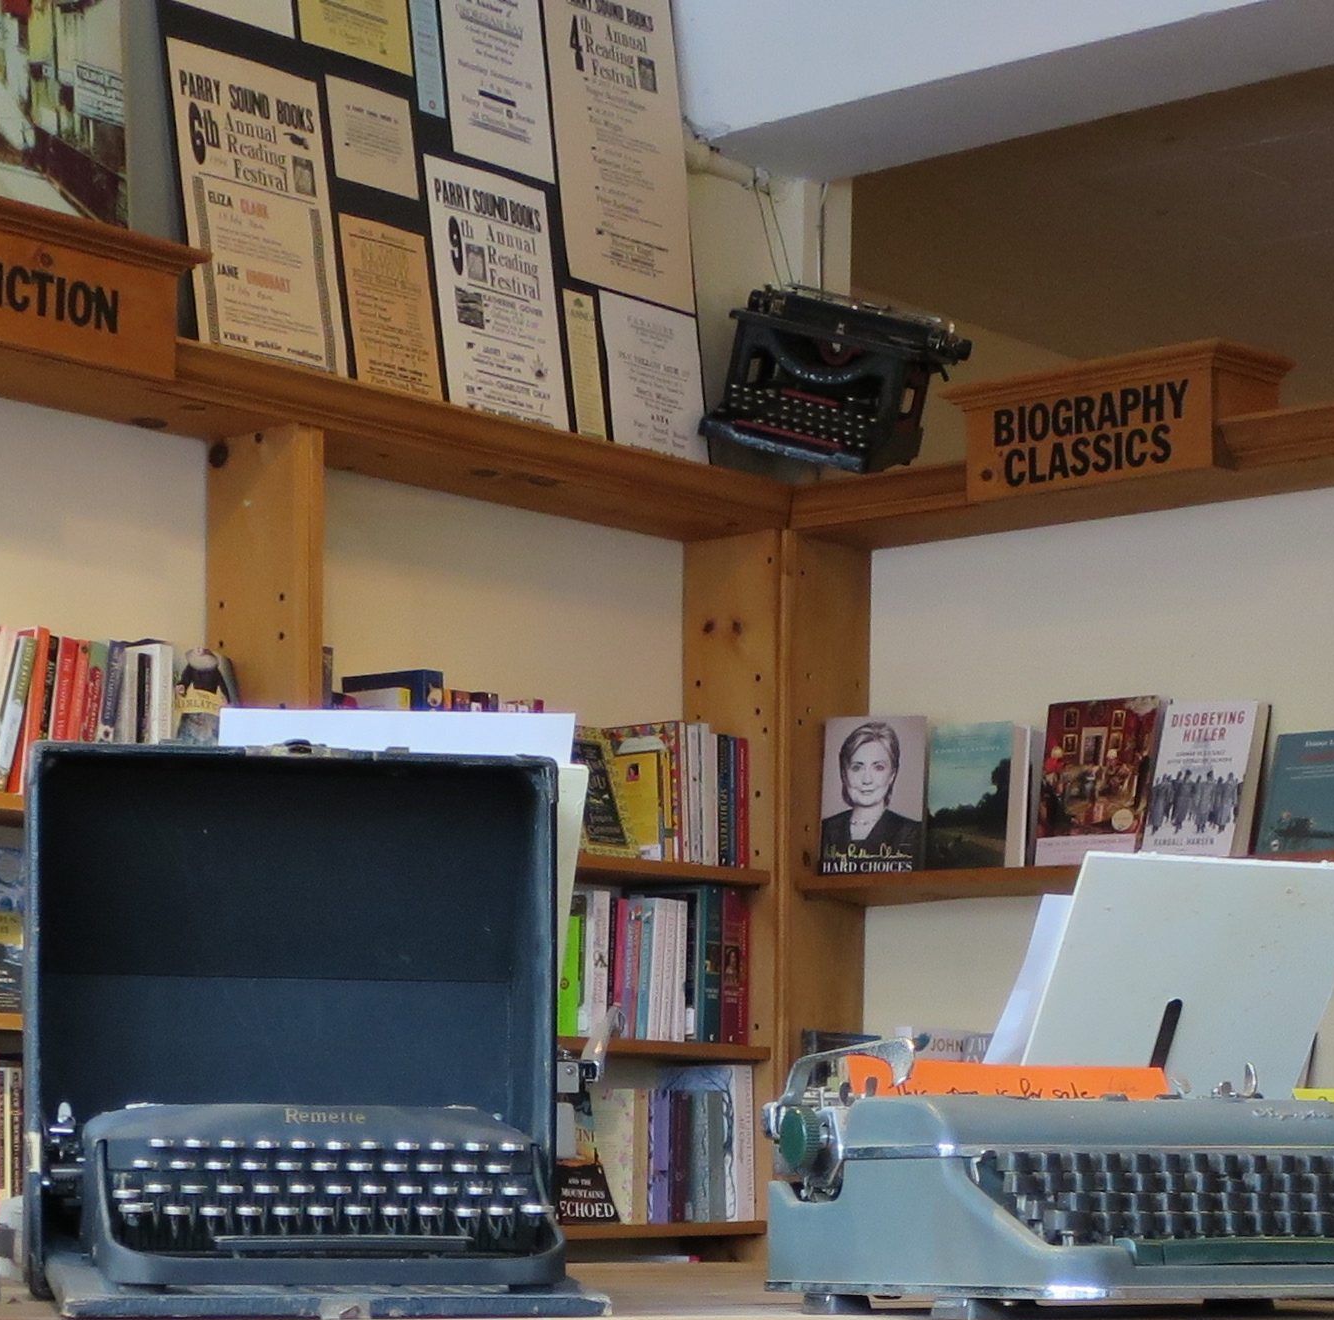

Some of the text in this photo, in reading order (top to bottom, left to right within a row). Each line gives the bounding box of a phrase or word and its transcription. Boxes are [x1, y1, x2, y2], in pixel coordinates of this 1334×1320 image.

[626, 7, 654, 32] BOOKS
[570, 15, 592, 71] 4th
[606, 25, 647, 52] Annual
[585, 37, 634, 66] Reading
[592, 59, 637, 89] Festival
[179, 69, 314, 133] PARRY SOUND BOOKS
[189, 101, 277, 165] 6th Annual
[227, 133, 286, 165] Reading
[234, 159, 288, 192] Festival
[434, 178, 542, 233] PARRY SOUND BOOKS
[448, 216, 536, 275] 9th Annual
[488, 246, 538, 279] Reading
[490, 271, 540, 301] Festival
[993, 379, 1188, 447] BIOGRAPHY
[1004, 425, 1172, 487] CLASSICS
[1171, 711, 1245, 727] DISOBEYING
[1182, 727, 1227, 742] HITLER
[823, 861, 912, 873] HARD CHOICES
[284, 1108, 366, 1125] Remette
